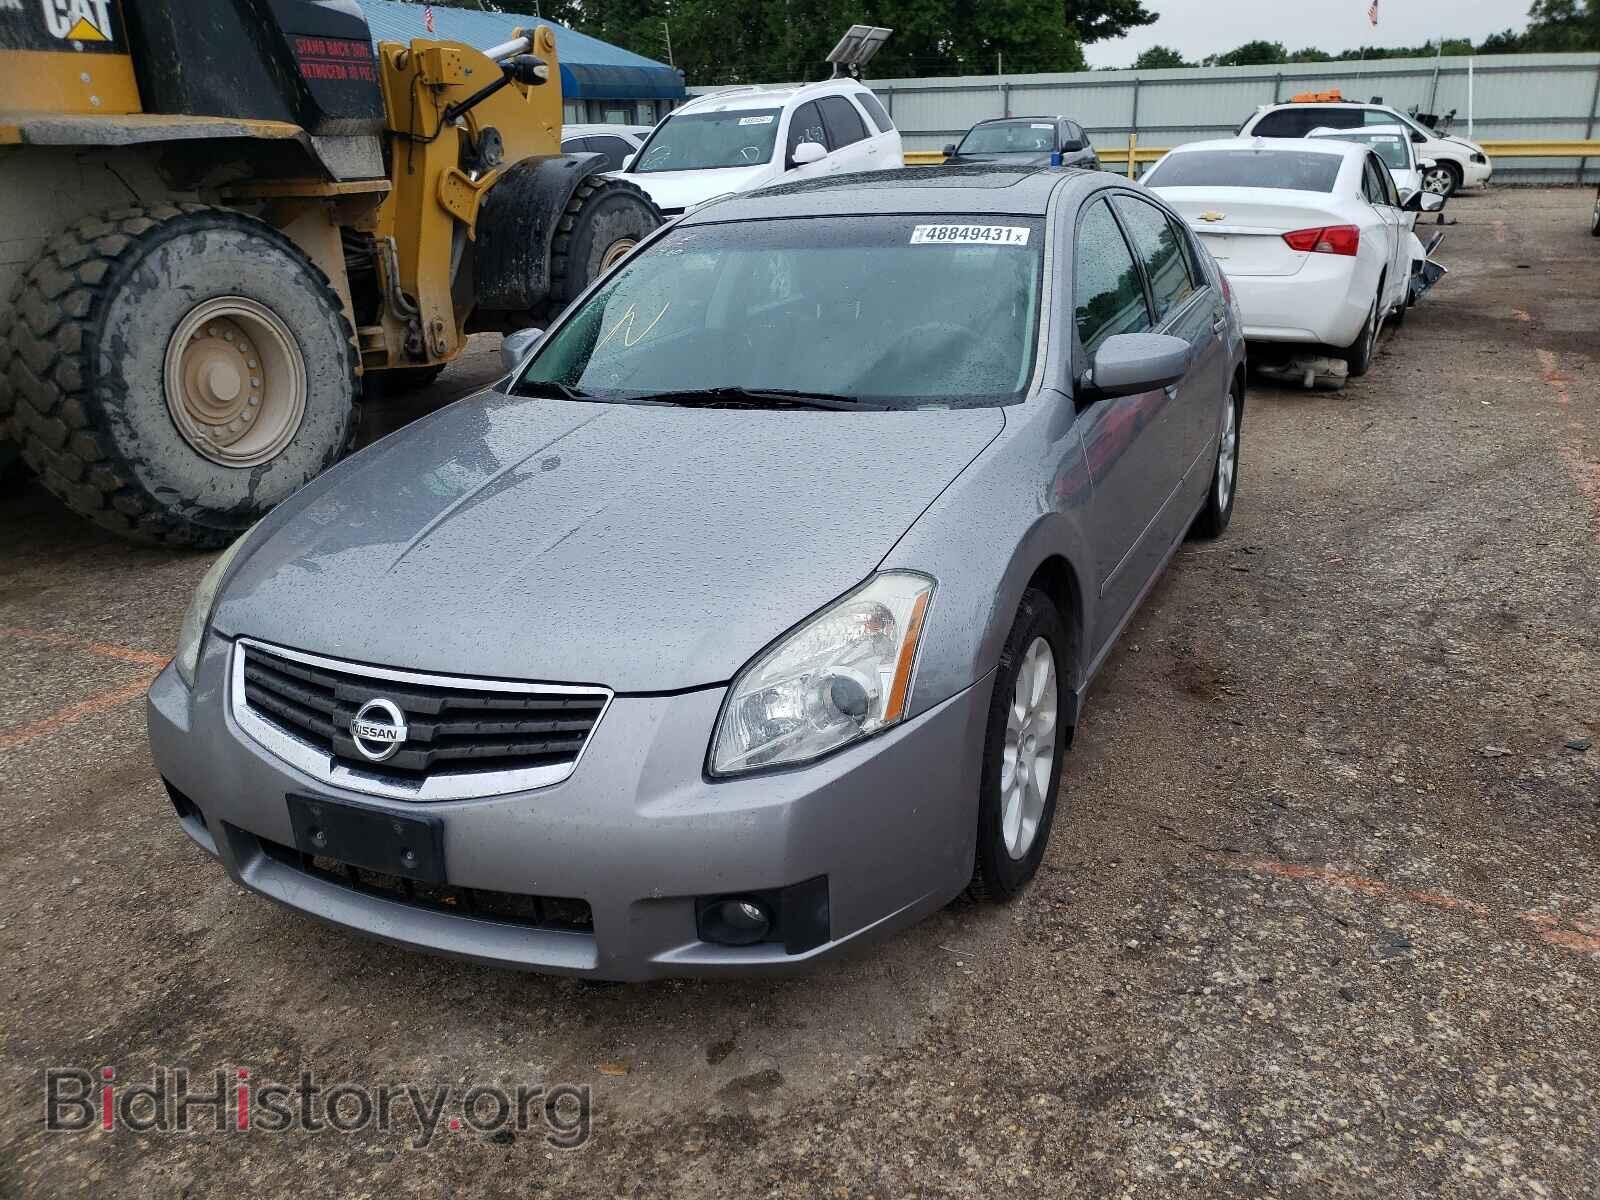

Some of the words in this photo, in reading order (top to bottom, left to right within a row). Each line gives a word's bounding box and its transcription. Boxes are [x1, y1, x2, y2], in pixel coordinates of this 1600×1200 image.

[40, 0, 114, 41] CAT
[926, 226, 1012, 241] 48849431
[353, 723, 397, 740] NISSAN
